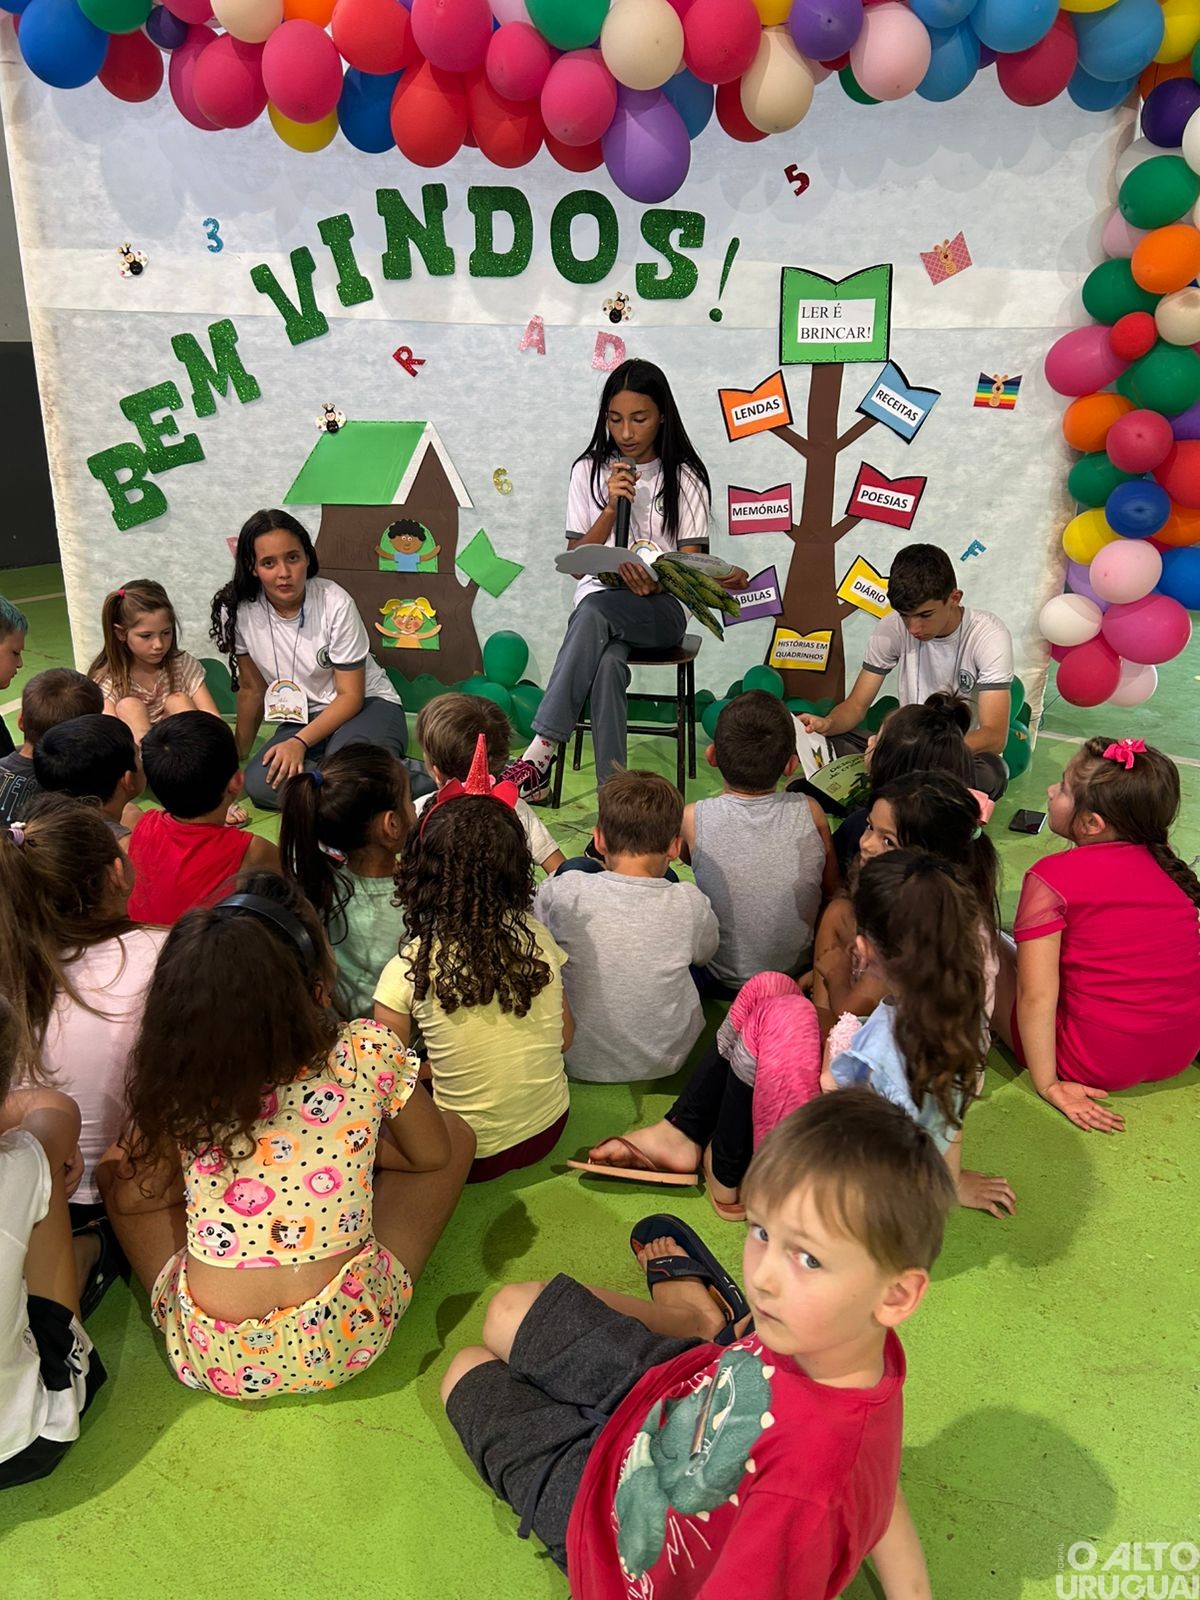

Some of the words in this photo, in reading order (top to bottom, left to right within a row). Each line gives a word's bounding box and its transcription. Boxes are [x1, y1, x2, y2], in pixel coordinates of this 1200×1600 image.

[783, 163, 810, 197] 5
[202, 217, 224, 253] 3
[801, 306, 829, 319] LER
[833, 303, 842, 318] É
[517, 314, 546, 355] A
[800, 326, 871, 340] BRINCAR!
[87, 319, 261, 531] BEM
[250, 183, 741, 346] VINDOS!
[392, 345, 426, 378] R
[591, 330, 626, 373] D
[734, 398, 780, 421] LENDAS
[876, 390, 918, 421] RECEITAS
[492, 467, 513, 496] 6
[732, 503, 789, 517] MEMÓRIAS
[860, 489, 909, 509] POESIAS
[960, 539, 986, 562] F
[853, 580, 886, 604] DIÁRIO
[775, 651, 824, 661] QUADRINHOS
[777, 639, 815, 649] HISTÓRIAS
